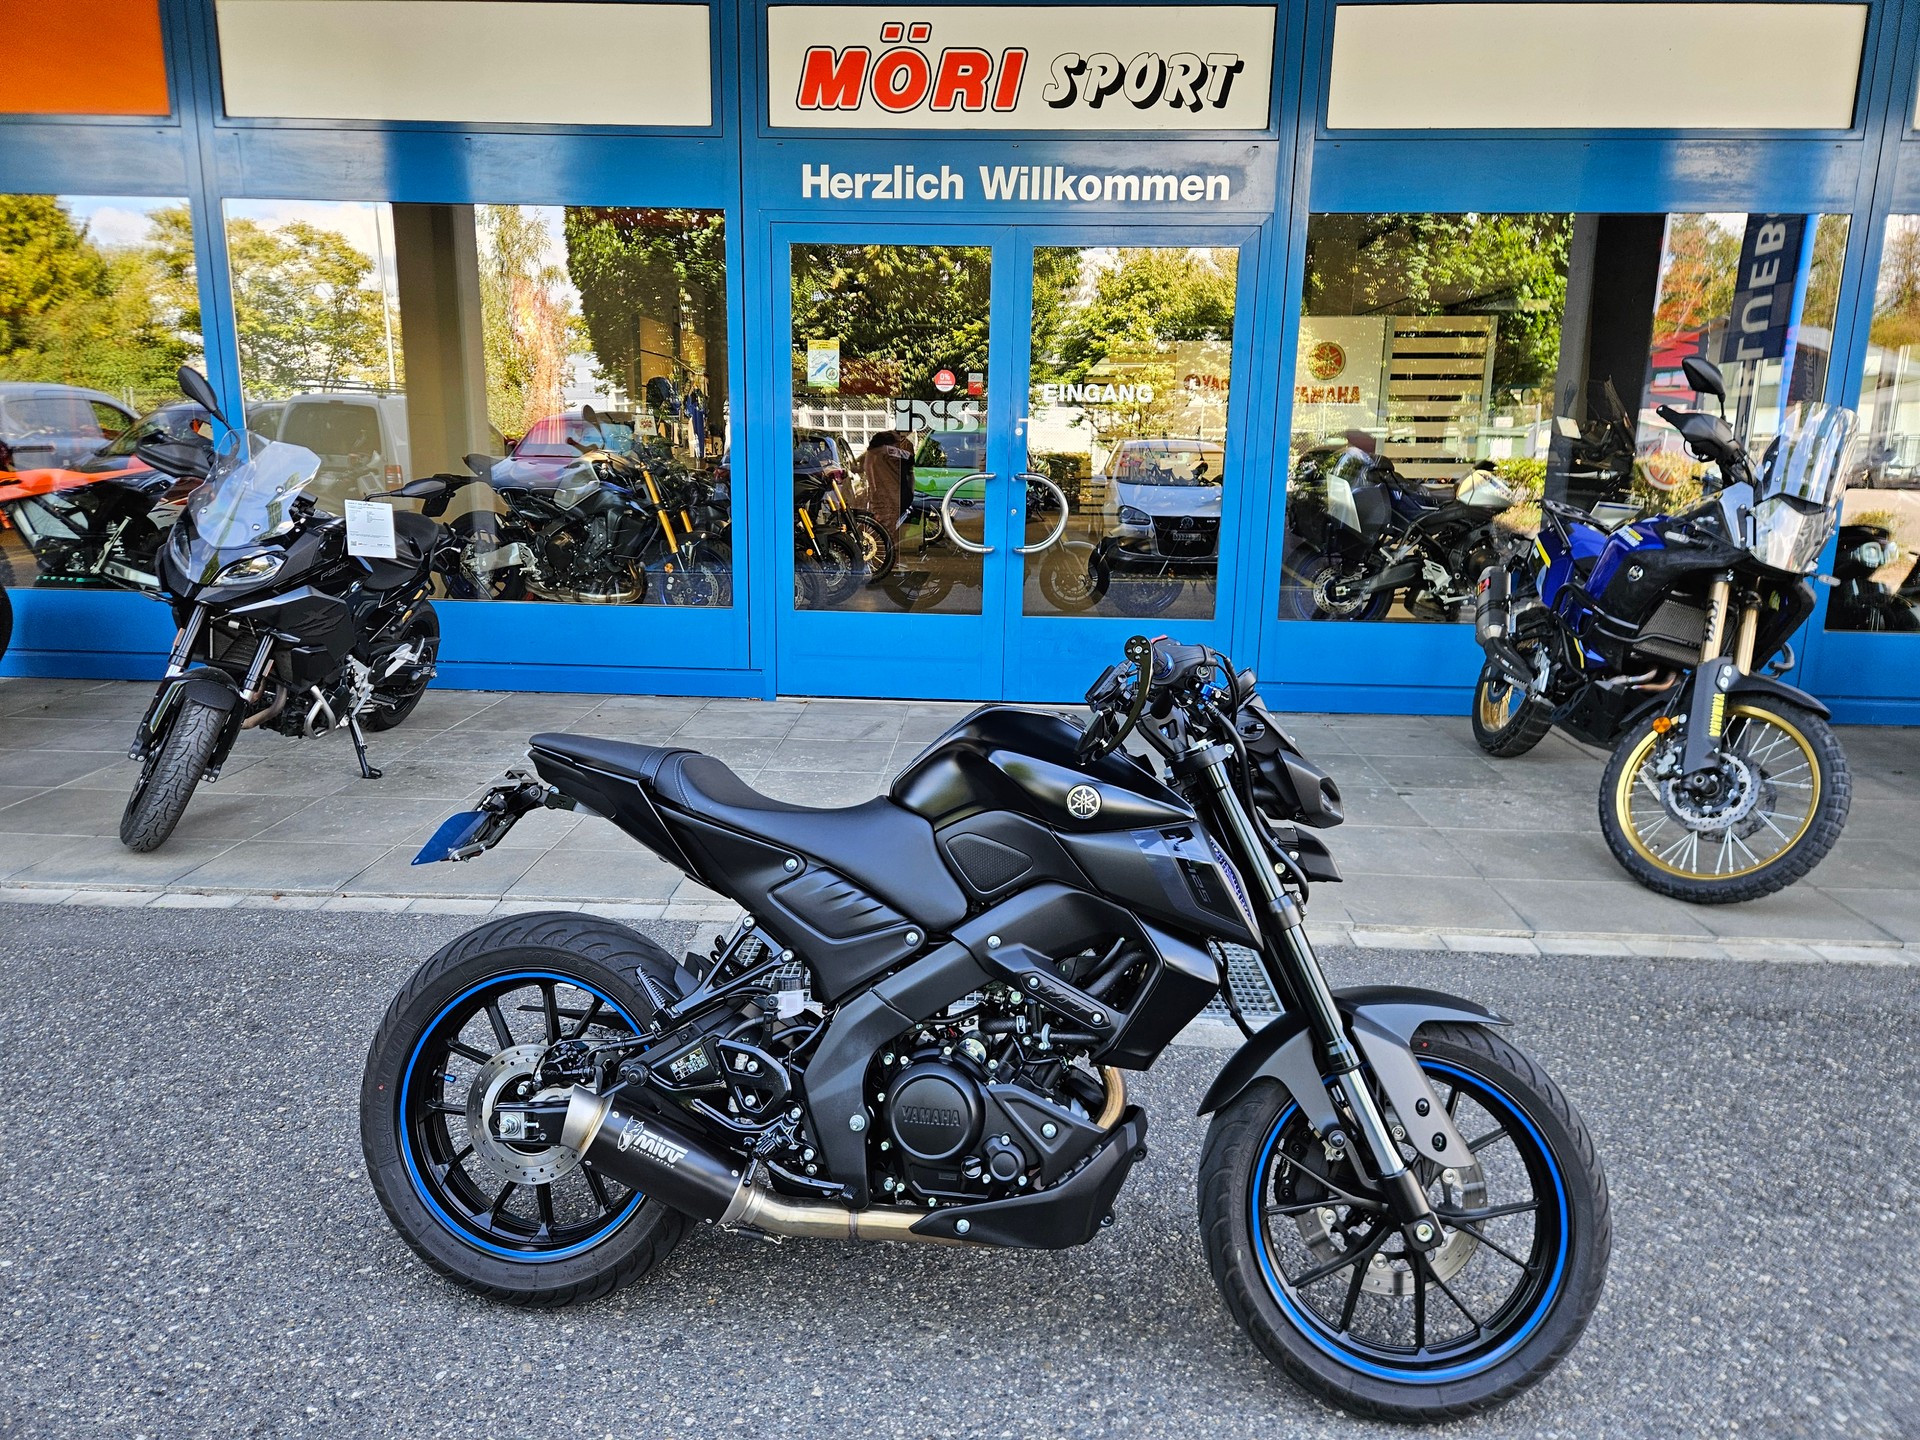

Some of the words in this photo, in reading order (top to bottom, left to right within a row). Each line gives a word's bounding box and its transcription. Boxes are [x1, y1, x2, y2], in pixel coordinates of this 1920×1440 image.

[797, 22, 1028, 113] MÖRI
[1042, 51, 1244, 112] SPORT
[802, 164, 964, 199] Herzlich
[979, 165, 1230, 201] Willkommen
[1042, 384, 1154, 403] EINGANG
[1708, 693, 1726, 738] YAMAHA
[902, 1105, 961, 1127] YAMAHA
